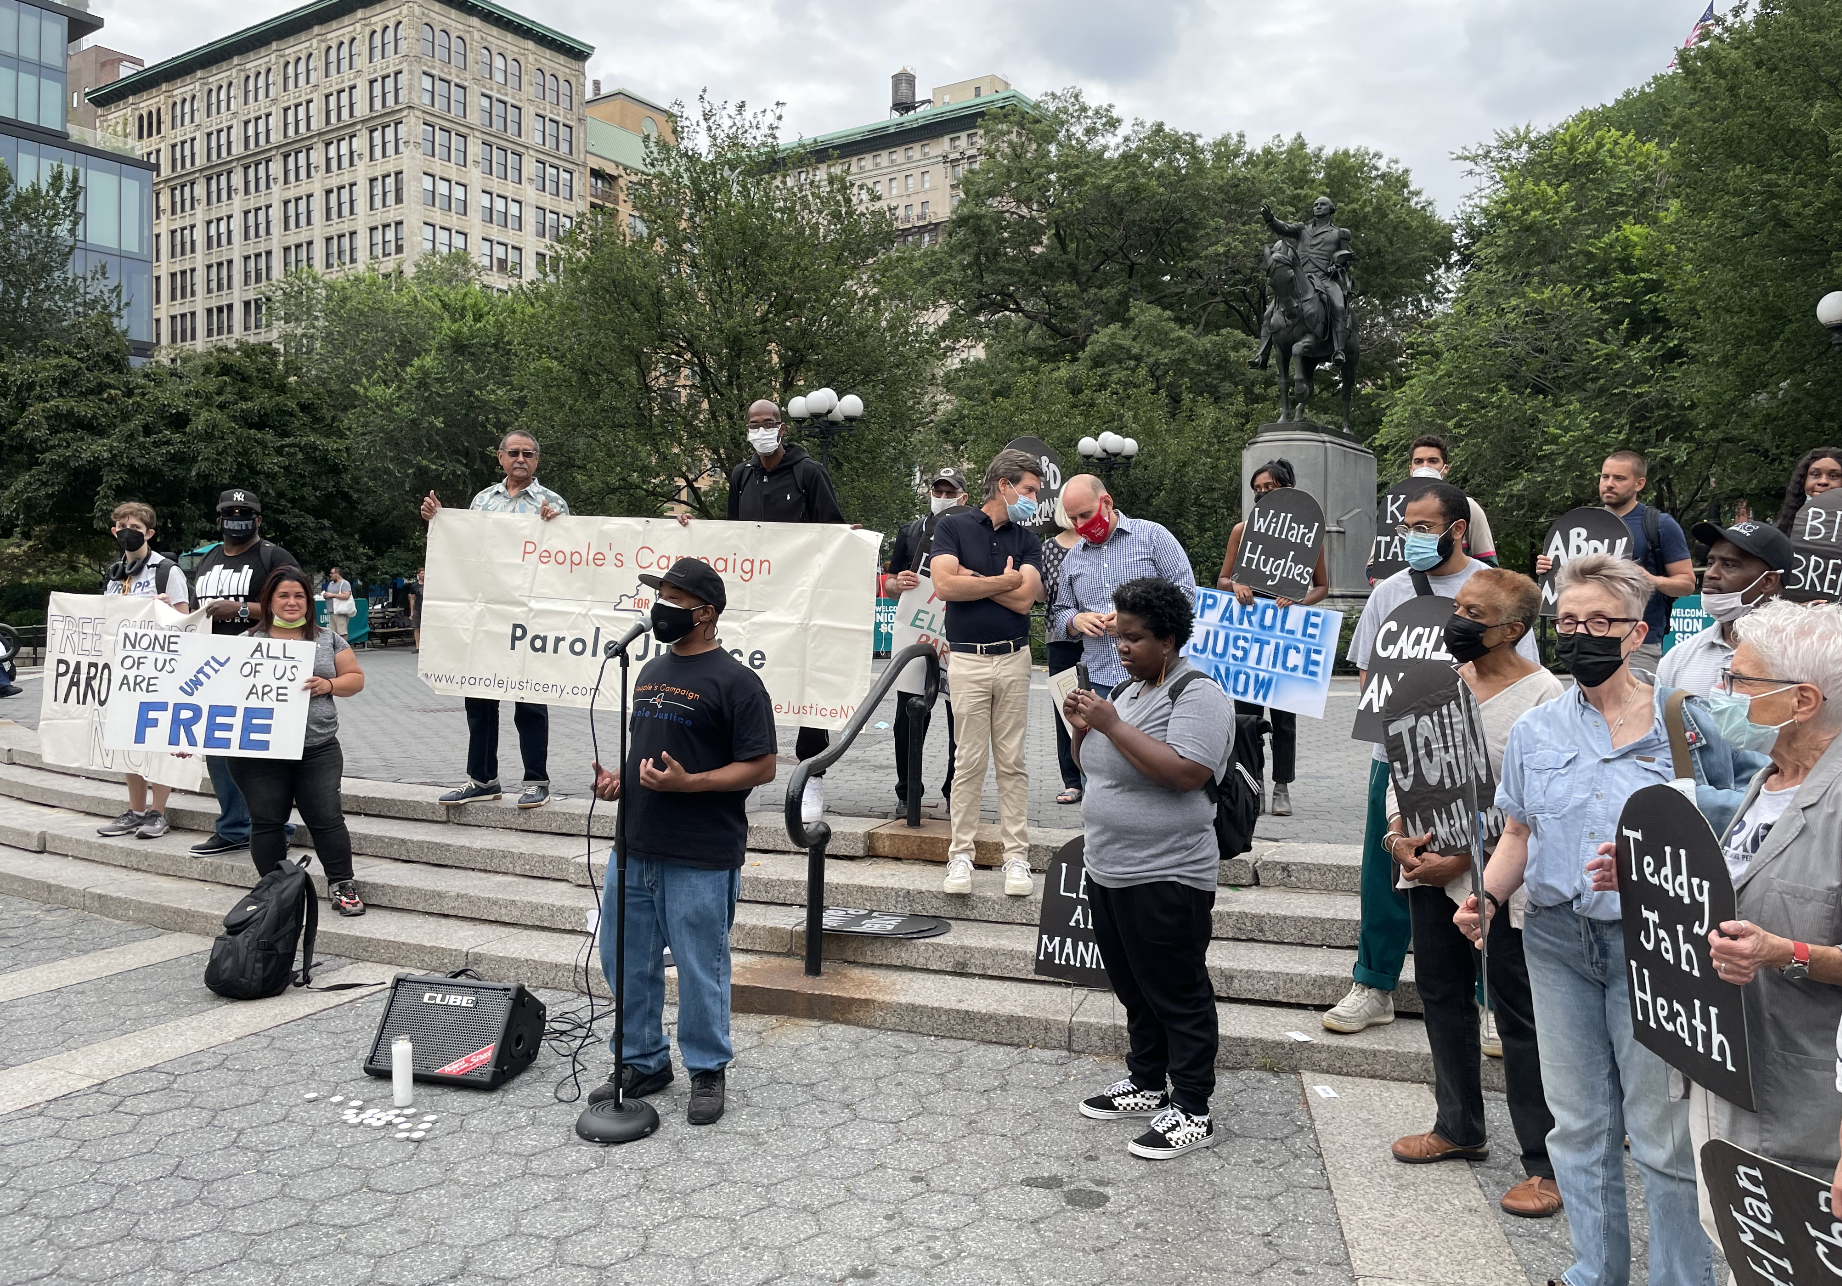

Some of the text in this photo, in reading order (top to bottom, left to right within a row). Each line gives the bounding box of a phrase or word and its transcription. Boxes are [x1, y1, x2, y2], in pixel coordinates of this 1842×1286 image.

[1253, 507, 1319, 548] Willard
[522, 540, 624, 573] People's
[1241, 541, 1314, 586] Hughes
[633, 597, 650, 610] FOR
[1199, 592, 1322, 639] PAROLE
[48, 614, 106, 657] FREE
[122, 632, 181, 653] NONE
[250, 641, 296, 659] ALL
[634, 633, 766, 670] Juce
[1192, 628, 1321, 678] JUSTICE
[118, 674, 159, 693] ARE
[120, 655, 178, 674] OF US
[178, 655, 231, 697] UNTIL
[240, 661, 299, 682] OF US
[1212, 664, 1274, 703] NOW
[245, 683, 289, 703] ARE
[659, 683, 700, 701] Campaign
[134, 701, 275, 751] FREE
[653, 708, 693, 727] Justice
[1388, 694, 1487, 792] JOHN
[1622, 825, 1710, 936] Teddy
[1639, 904, 1701, 977] Jah
[423, 992, 475, 1007] CUBE
[1629, 959, 1736, 1072] Heath
